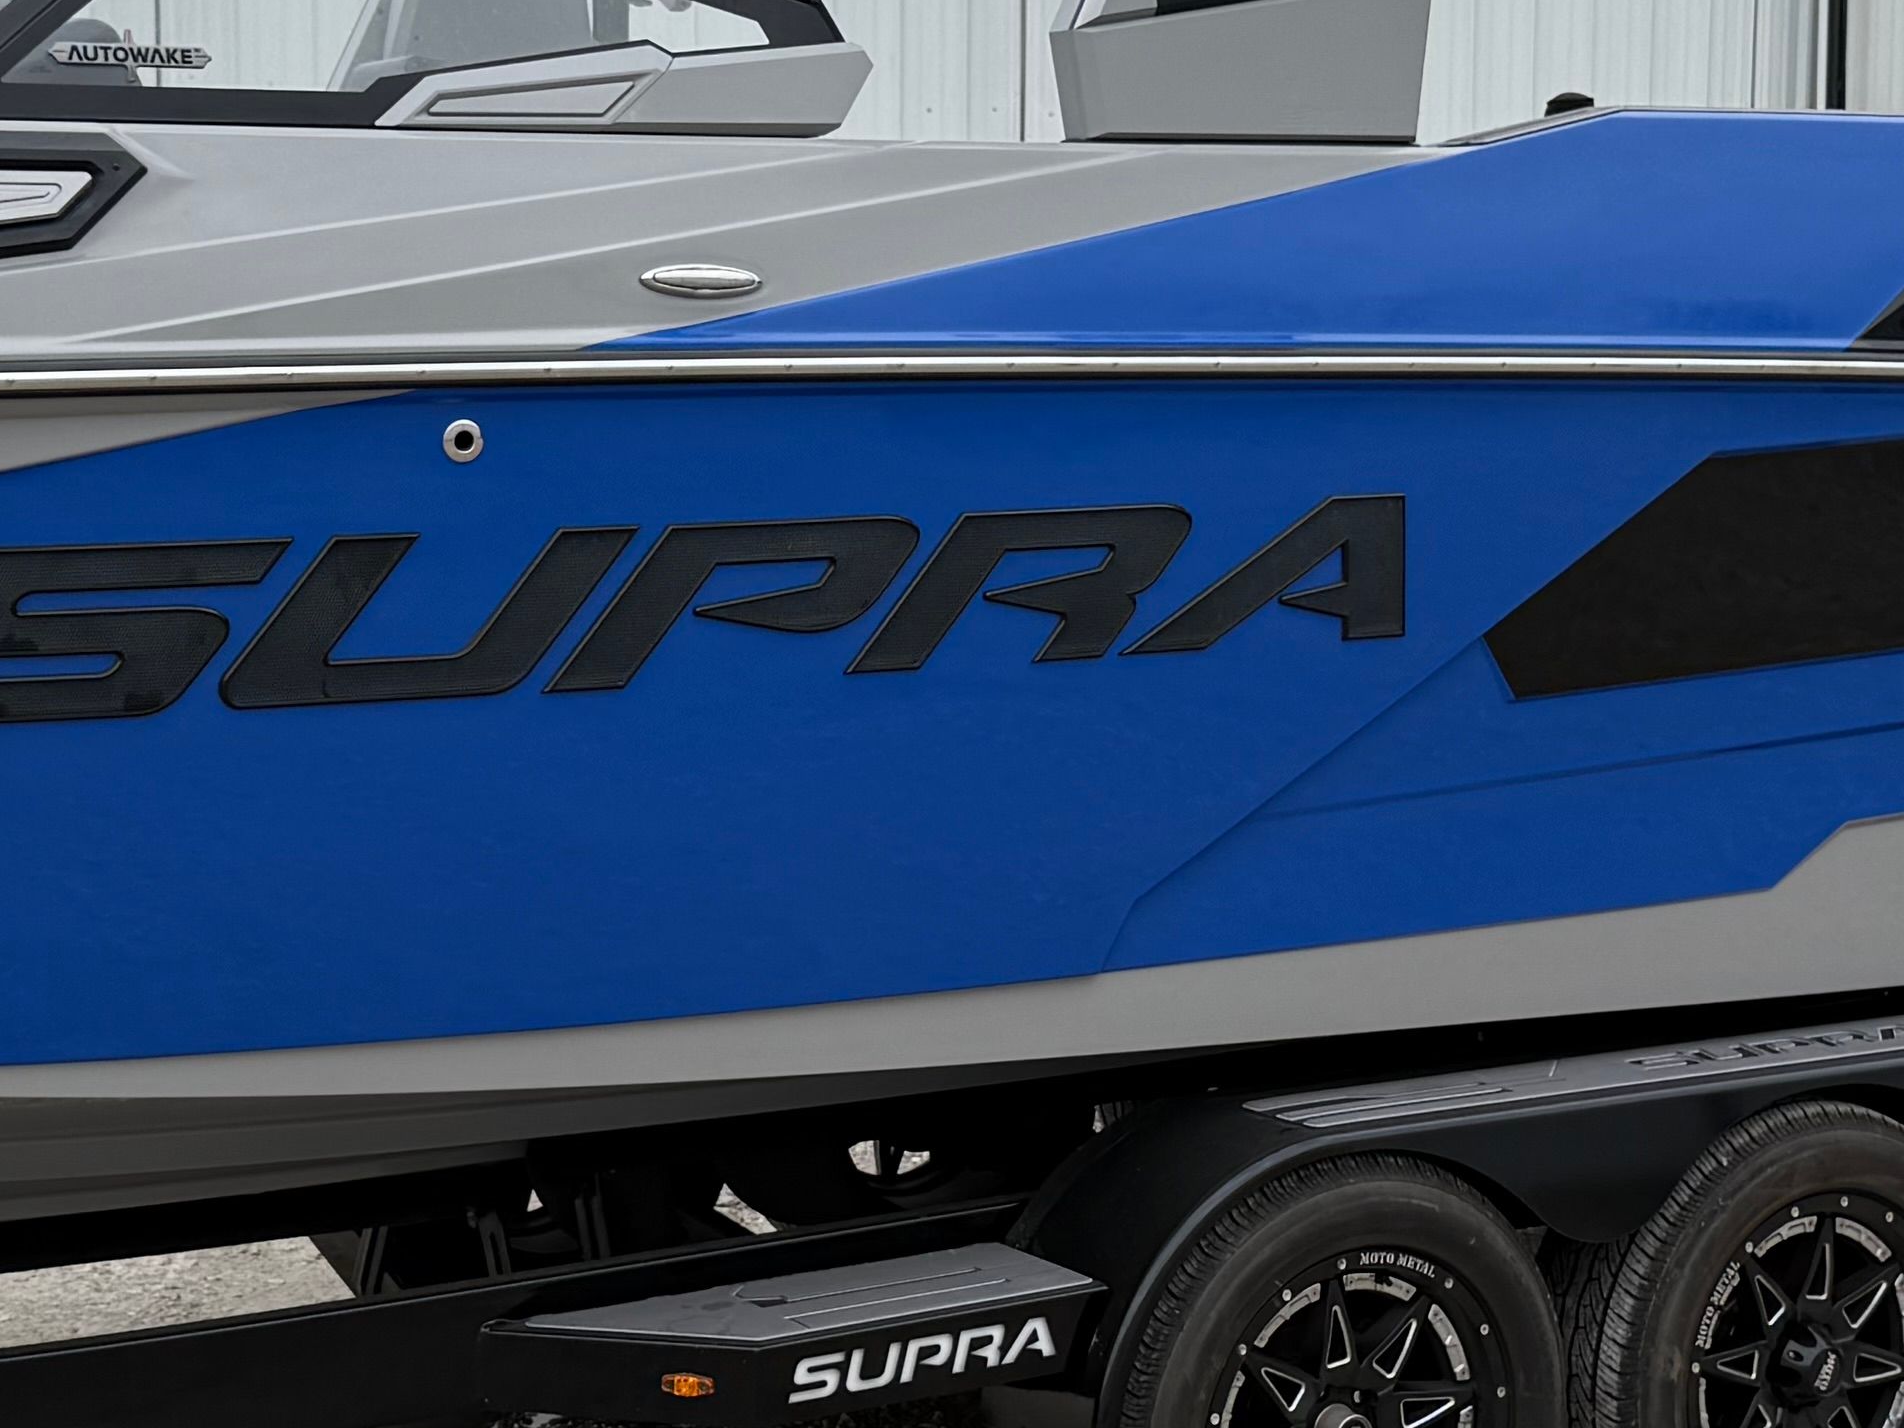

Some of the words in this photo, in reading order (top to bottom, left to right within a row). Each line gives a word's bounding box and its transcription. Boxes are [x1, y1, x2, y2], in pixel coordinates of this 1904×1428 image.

[68, 44, 194, 65] AUTOWAKE
[1359, 1251, 1395, 1265] MOTO
[1396, 1253, 1436, 1278] METAL
[1695, 1306, 1715, 1347] MOTO
[1709, 1261, 1741, 1305] METAL
[787, 1316, 1058, 1404] SUPRA
